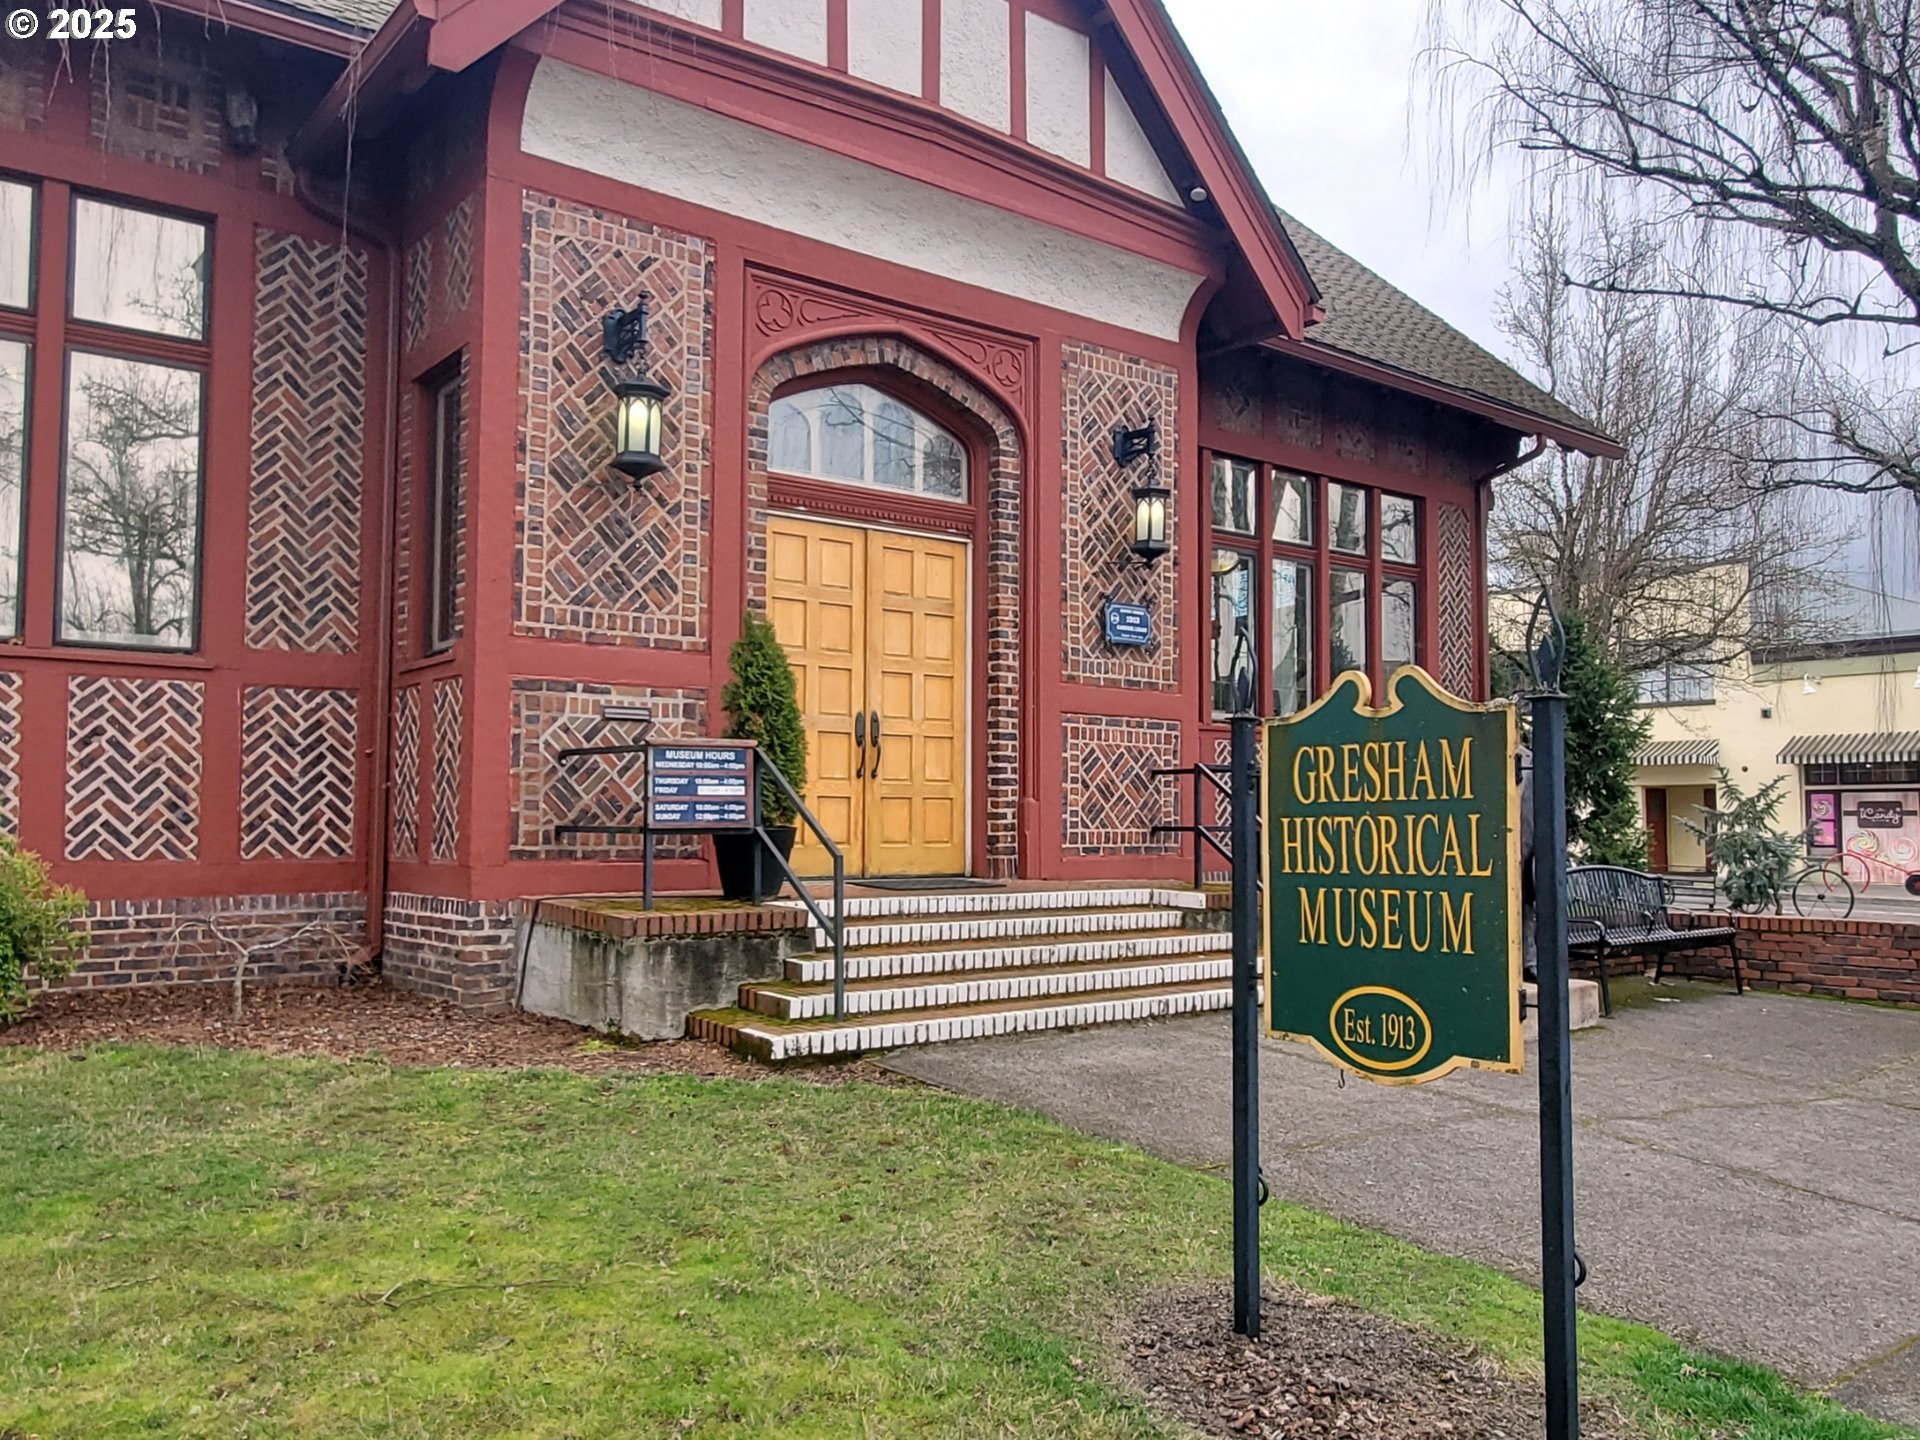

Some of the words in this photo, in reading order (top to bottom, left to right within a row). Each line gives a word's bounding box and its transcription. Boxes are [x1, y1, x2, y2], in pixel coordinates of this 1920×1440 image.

[665, 750, 704, 759] MUSEUM
[705, 751, 736, 760] HOURS
[1292, 737, 1475, 805] GRESHAM
[1859, 807, 1901, 824] iCandy
[1280, 813, 1494, 878] HISTORICAL
[1297, 886, 1476, 955] MUSEUM
[1343, 1009, 1376, 1045] Est.
[1381, 1012, 1416, 1050] 1913
